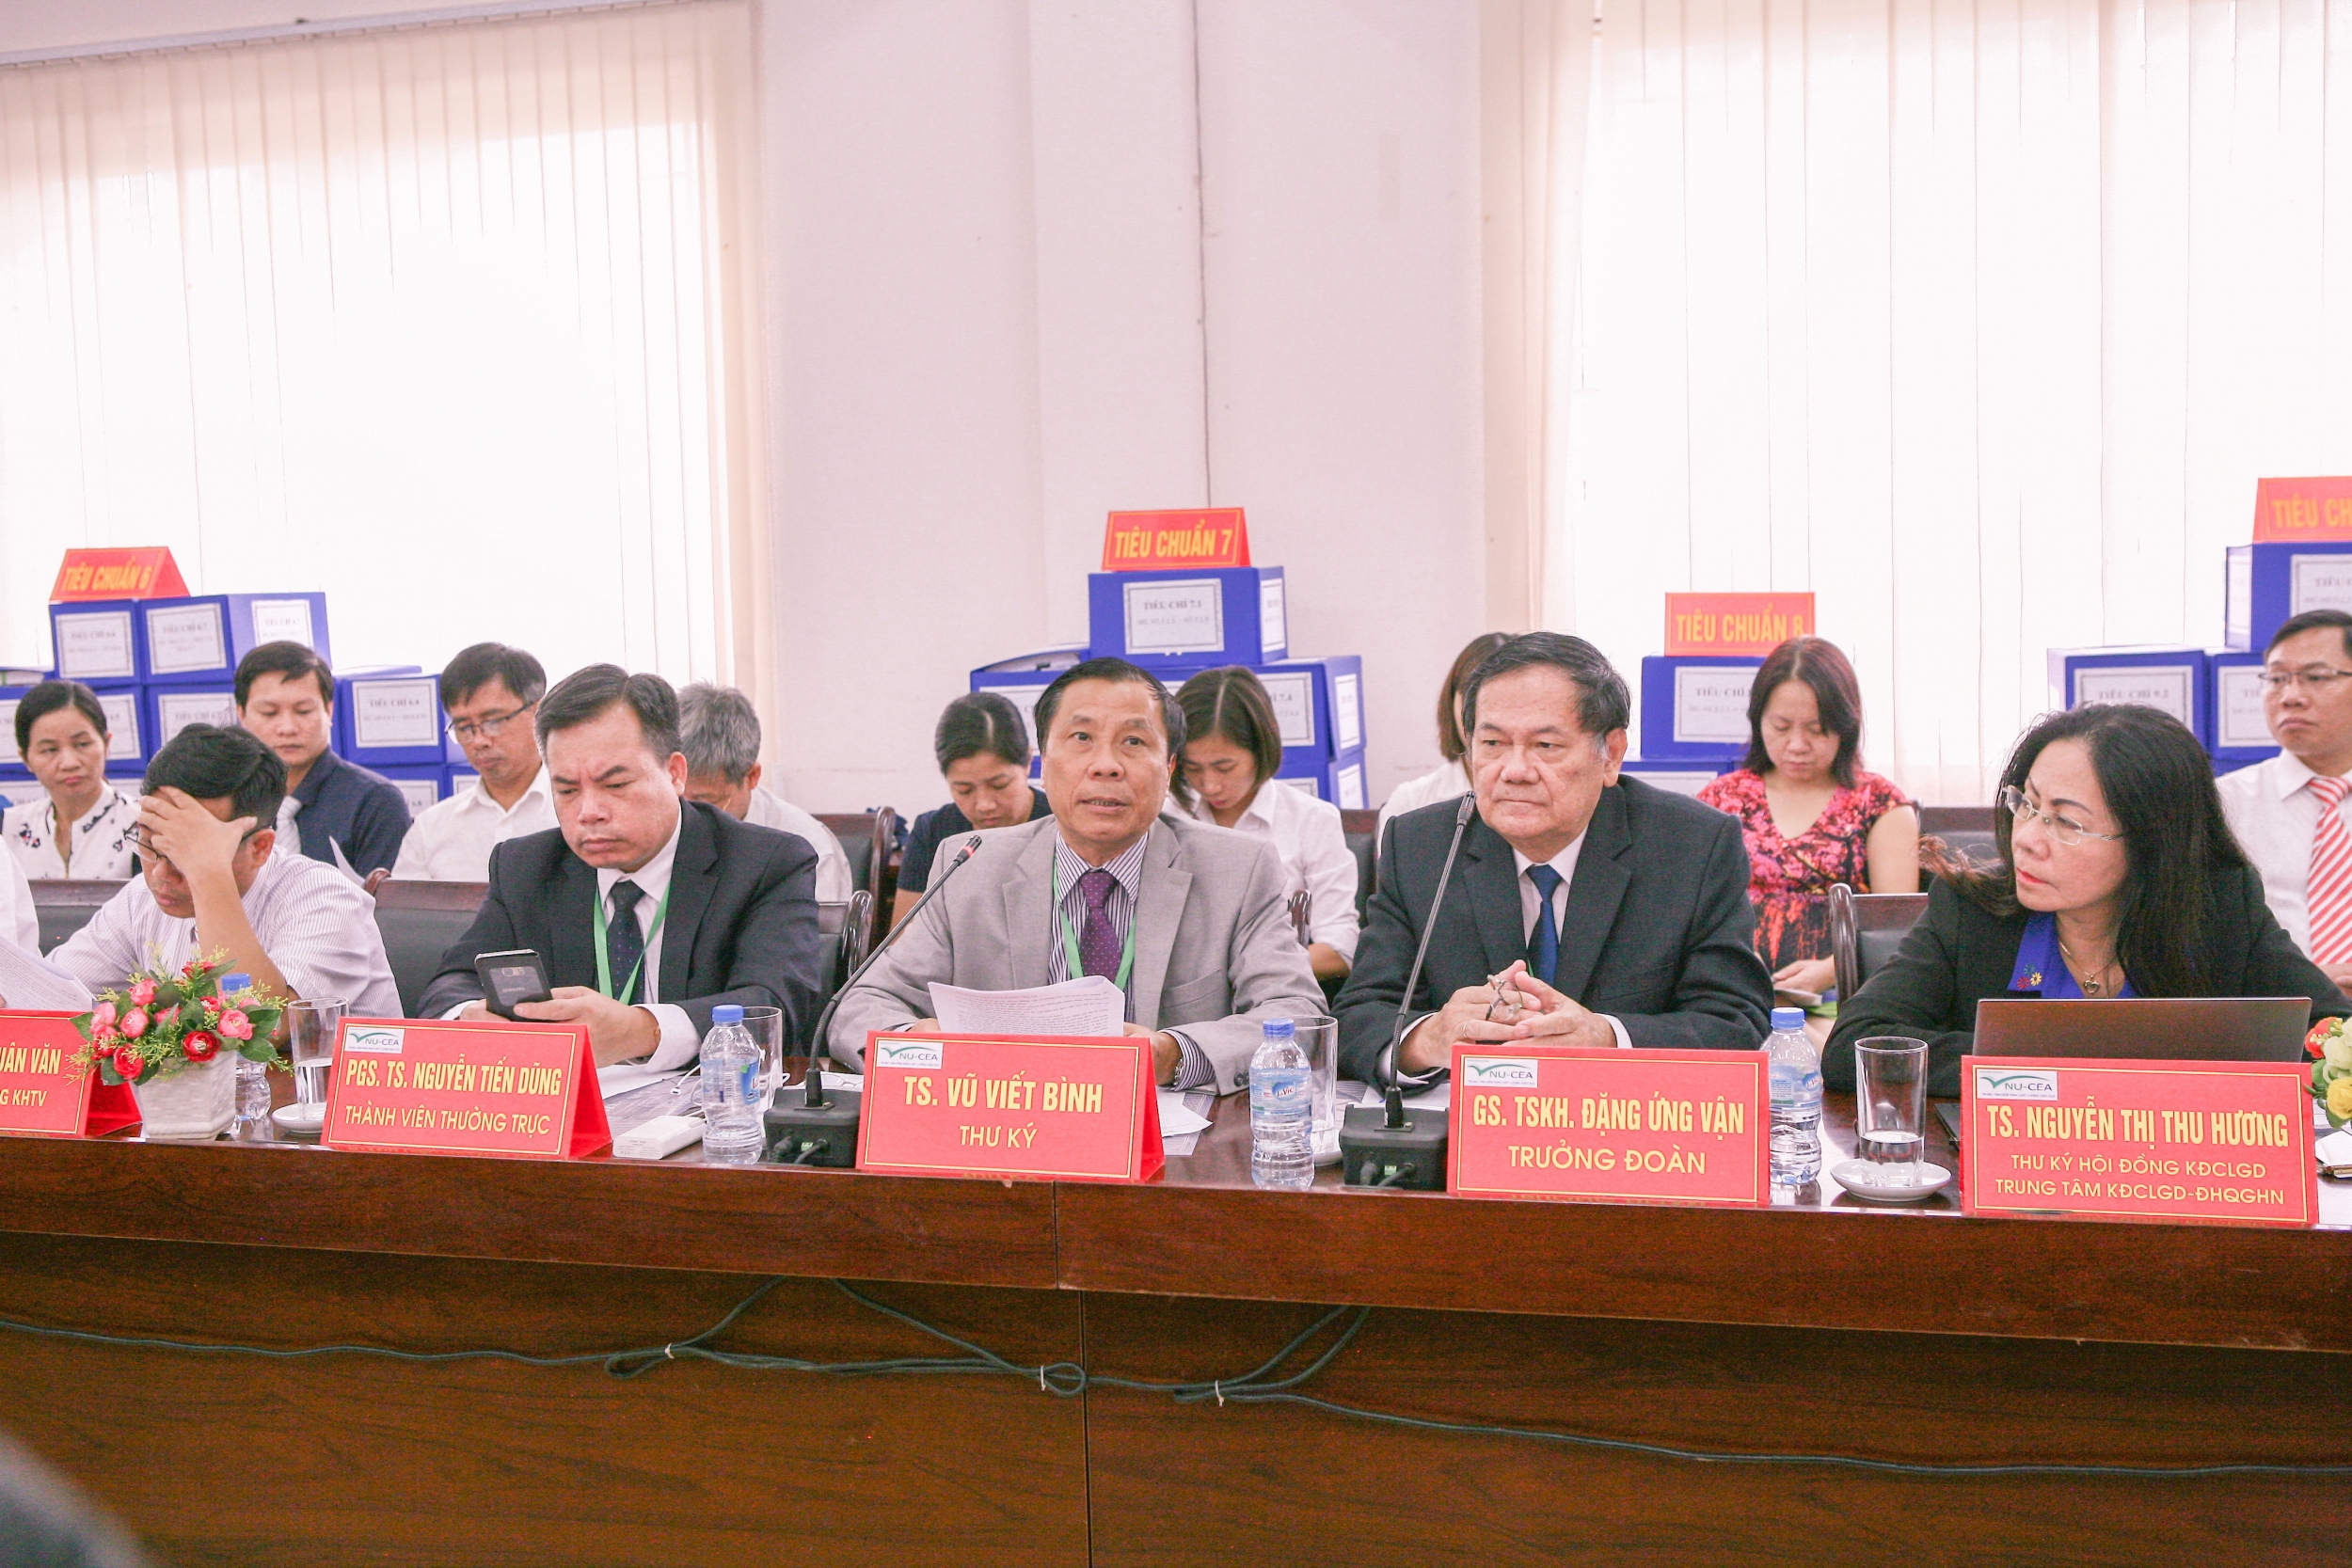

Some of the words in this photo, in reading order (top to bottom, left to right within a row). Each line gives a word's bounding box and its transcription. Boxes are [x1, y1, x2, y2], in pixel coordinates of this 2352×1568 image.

[2271, 493, 2319, 528] TIÊU
[1114, 525, 1152, 559] TIÊU
[1155, 518, 1216, 557] CHUẨN
[1220, 528, 1232, 556] 7
[61, 562, 94, 592] TIÊU
[91, 555, 142, 592] CHUẨN
[138, 565, 153, 590] 6
[1676, 608, 1717, 641] TIÊU
[1722, 602, 1788, 641] CHUẨN
[1792, 614, 1804, 639] 8
[30, 1042, 62, 1074] VĂN
[345, 1058, 380, 1087] PGS.
[386, 1060, 408, 1088] TS.
[412, 1053, 477, 1092] NGUYỄN
[480, 1055, 516, 1094] TIẾN
[516, 1062, 563, 1096] DŨNG
[11, 1089, 47, 1107] KHTV
[903, 1075, 939, 1106] TS.
[947, 1072, 978, 1108] VŨ
[985, 1069, 1037, 1111] VIẾT
[1041, 1076, 1103, 1114] BÌNH
[345, 1100, 397, 1127] THÀNH
[401, 1103, 437, 1129] VIÊN
[440, 1105, 507, 1132] THƯỜNG
[511, 1114, 551, 1139] TRỰC
[1472, 1094, 1507, 1127] GS.
[1514, 1096, 1575, 1129] TSKH.
[1581, 1091, 1642, 1136] ĐẶNG
[1648, 1090, 1693, 1132] ỨNG
[1699, 1095, 1744, 1141] VẬN
[1986, 1104, 2019, 1138] TS.
[2026, 1095, 2114, 1141] NGUYỄN
[2121, 1109, 2155, 1149] THỊ
[2161, 1110, 2204, 1145] THU
[2211, 1109, 2289, 1148] HƯƠNG
[959, 1125, 1002, 1148] THƯ
[1007, 1121, 1038, 1149] KÝ
[1508, 1139, 1616, 1171] TRƯỞNG
[1624, 1144, 1706, 1174] ĐOÀN
[2010, 1154, 2044, 1170] THƯ
[2050, 1151, 2074, 1171] KÝ
[2079, 1153, 2112, 1176] HỘI
[2119, 1153, 2180, 1175] ĐỒNG
[2185, 1161, 2266, 1179] KĐCLGD
[1995, 1179, 2057, 1196] TRUNG
[2061, 1178, 2101, 1197] TÂM
[2107, 1182, 2284, 1205] KĐCLGD-ĐHQGHN
